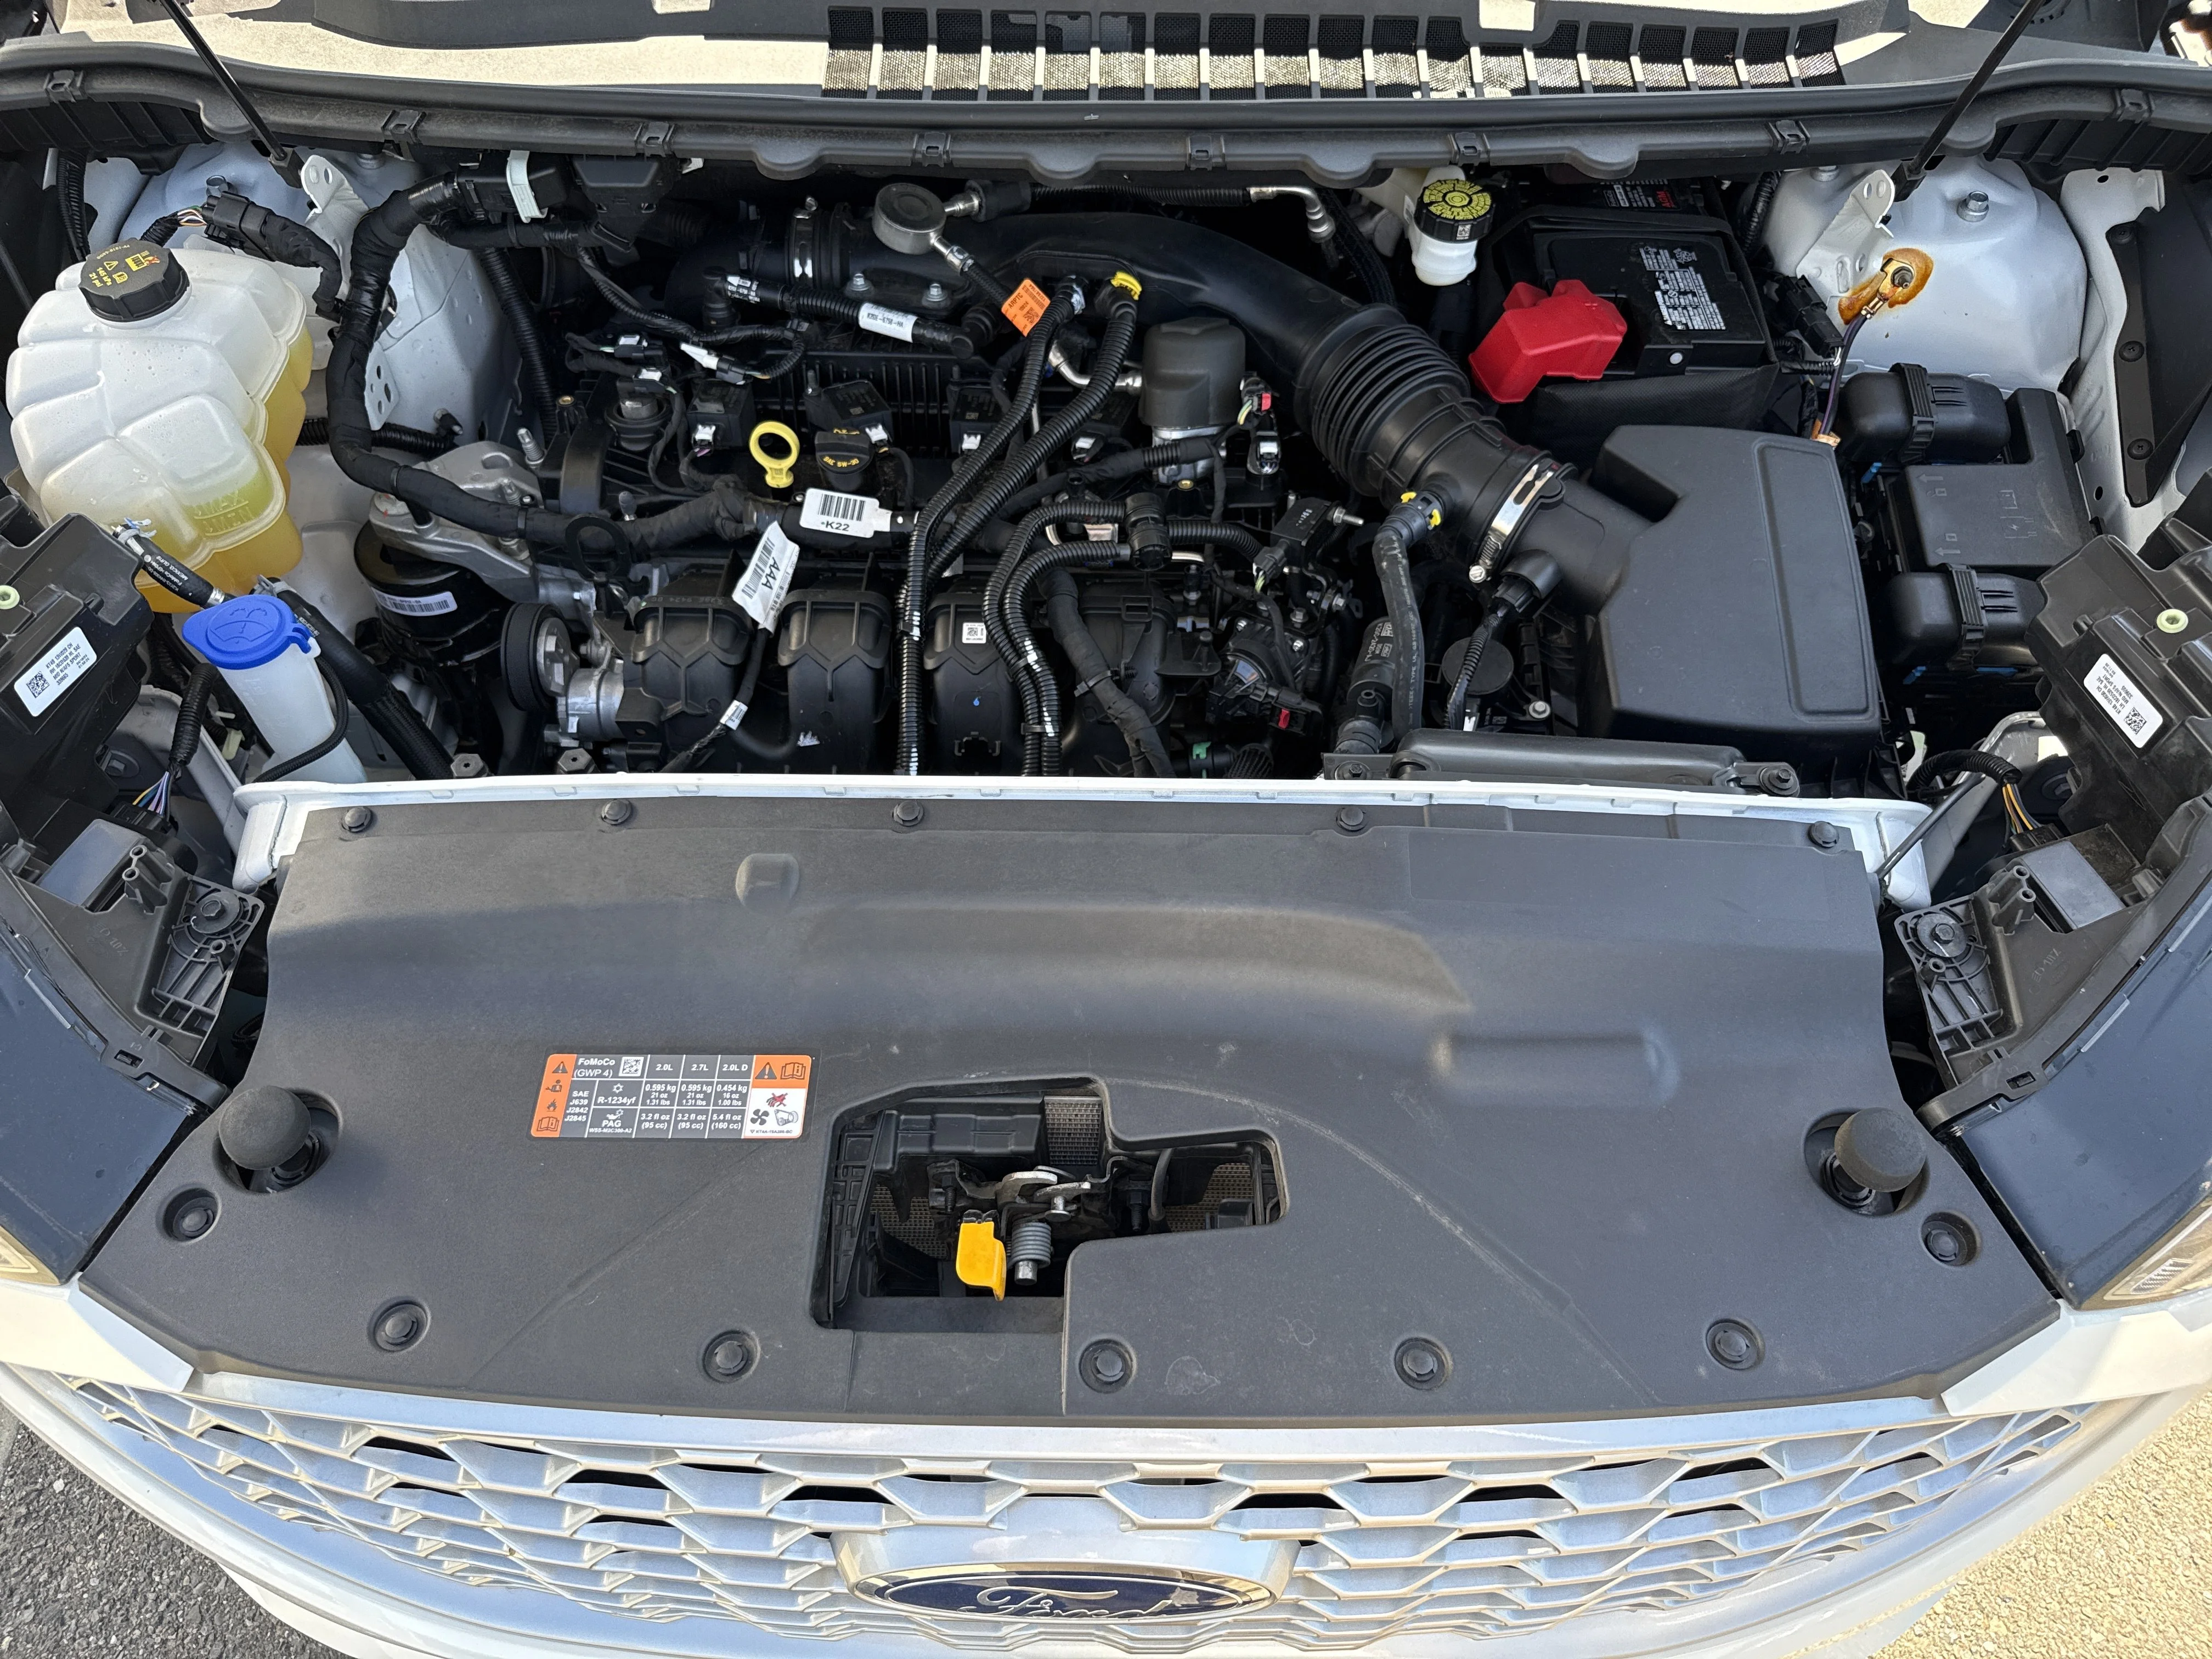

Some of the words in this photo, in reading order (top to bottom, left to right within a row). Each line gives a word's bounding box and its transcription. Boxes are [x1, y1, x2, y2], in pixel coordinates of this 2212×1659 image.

[97, 267, 107, 278] 145
[102, 275, 112, 286] kPa
[92, 278, 103, 287] psi
[1008, 292, 1023, 309] ARPTC
[823, 456, 836, 466] SAE
[837, 458, 859, 467] 5W-30
[761, 557, 780, 590] AAA
[70, 652, 81, 664] SPORT
[2103, 674, 2113, 686] SPORT
[574, 1069, 601, 1077] (GWP
[603, 1069, 613, 1078] 4)
[667, 1084, 676, 1093] kg
[703, 1084, 712, 1093] kg
[738, 1085, 747, 1093] kg
[597, 1097, 636, 1105] R-1234yf
[956, 1587, 1173, 1618] Ford
